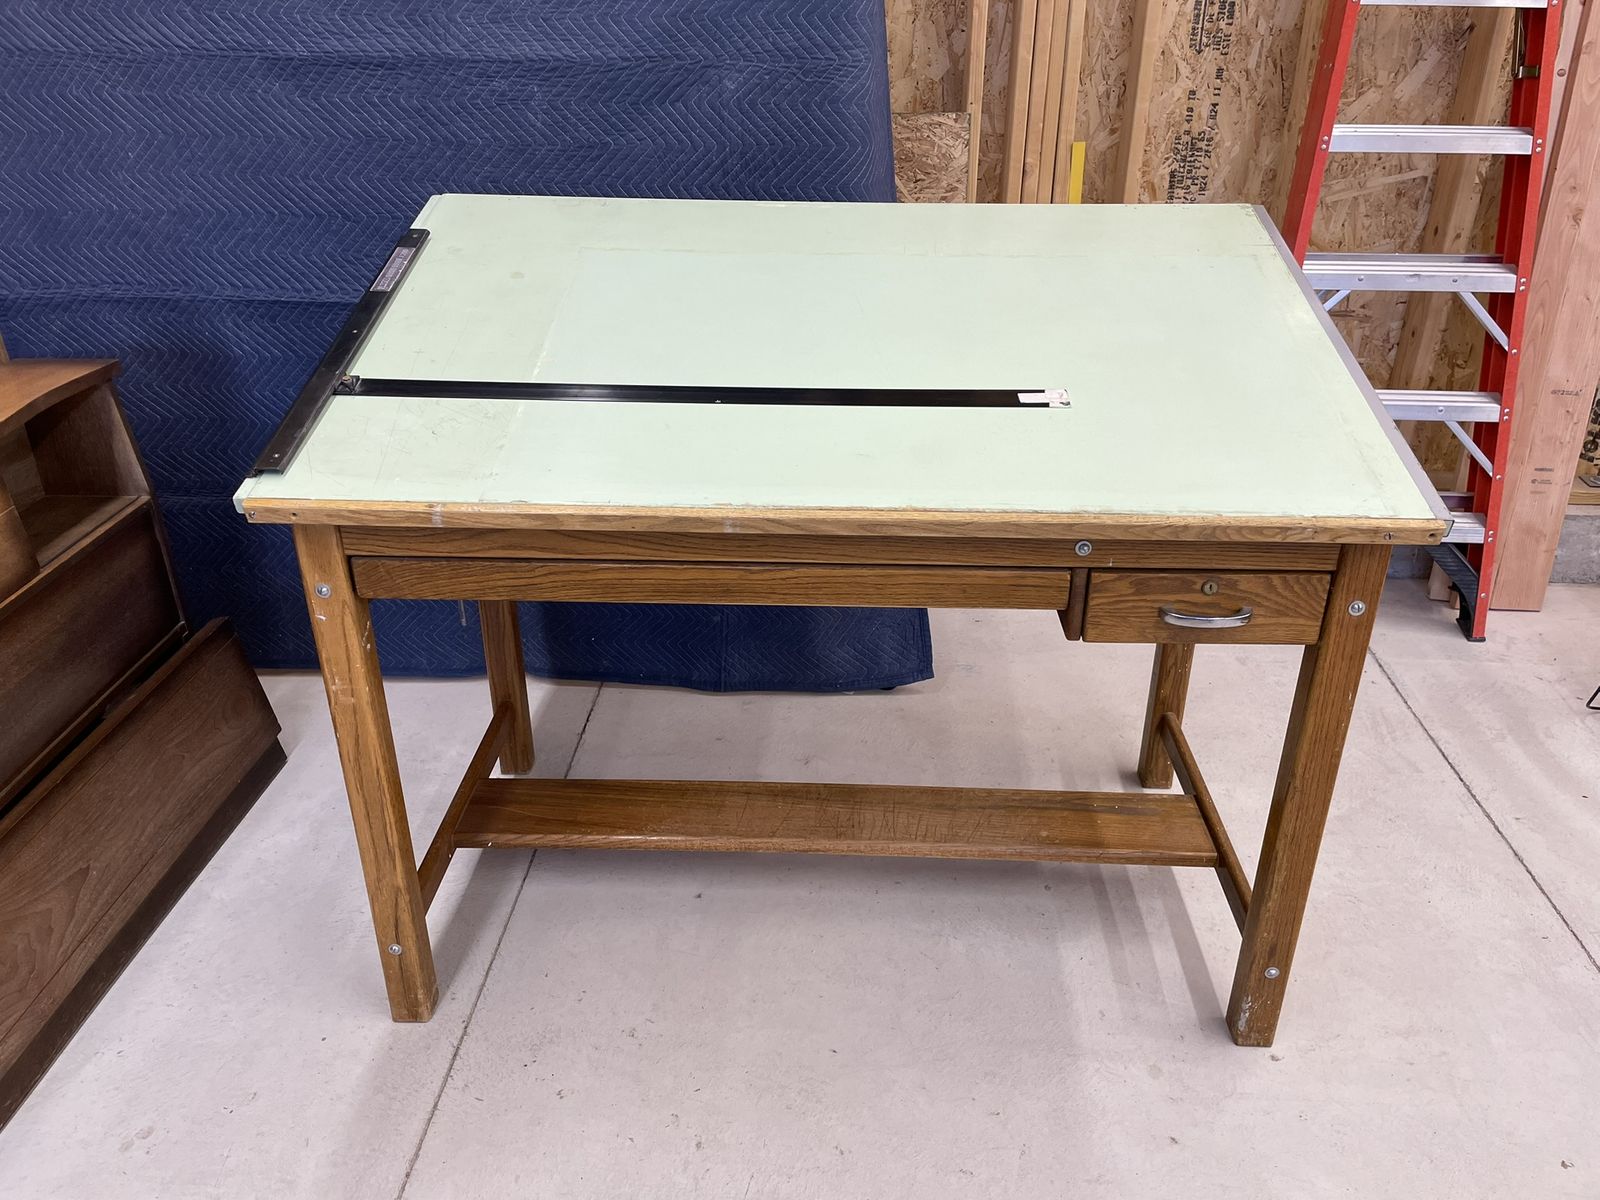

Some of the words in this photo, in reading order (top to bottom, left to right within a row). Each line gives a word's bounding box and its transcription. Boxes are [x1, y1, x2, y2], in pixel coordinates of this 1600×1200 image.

[1225, 1, 1236, 26] LADO
[1212, 28, 1223, 51] THIS
[1221, 32, 1232, 56] ESTE
